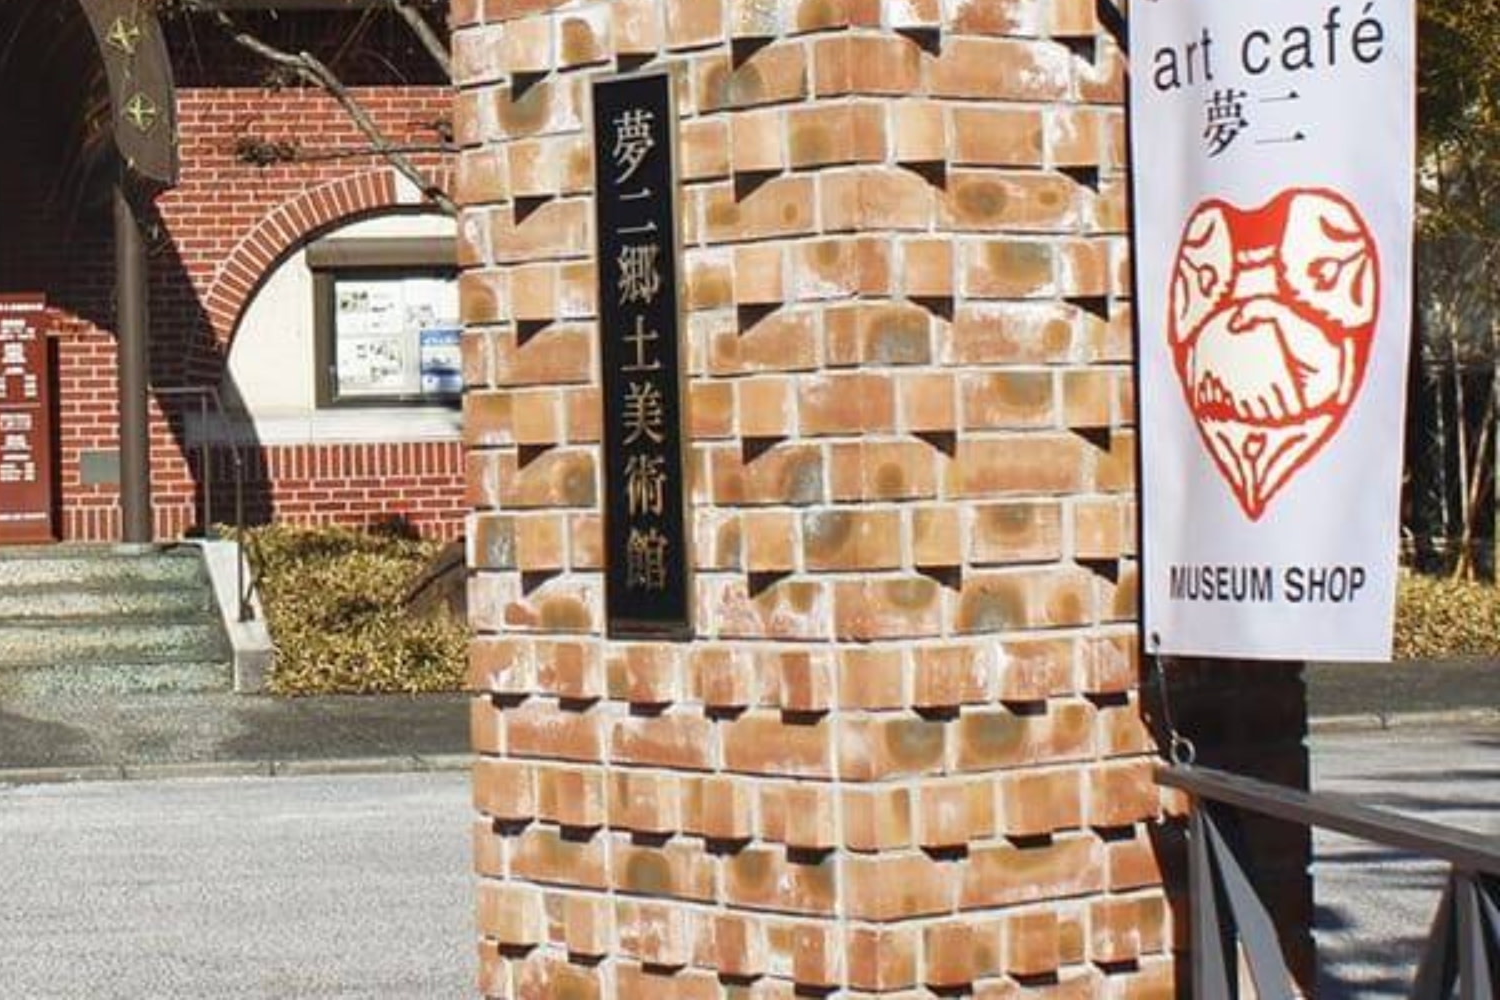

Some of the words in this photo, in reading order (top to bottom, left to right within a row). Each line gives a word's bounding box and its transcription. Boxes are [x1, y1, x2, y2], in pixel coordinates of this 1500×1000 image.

[1153, 26, 1213, 91] art
[1240, 2, 1384, 76] café
[1202, 87, 1306, 159] 夢二
[611, 107, 669, 591] 夢二郷土美術館
[1169, 565, 1274, 603] MUSEUM
[1284, 565, 1367, 604] SHOP
